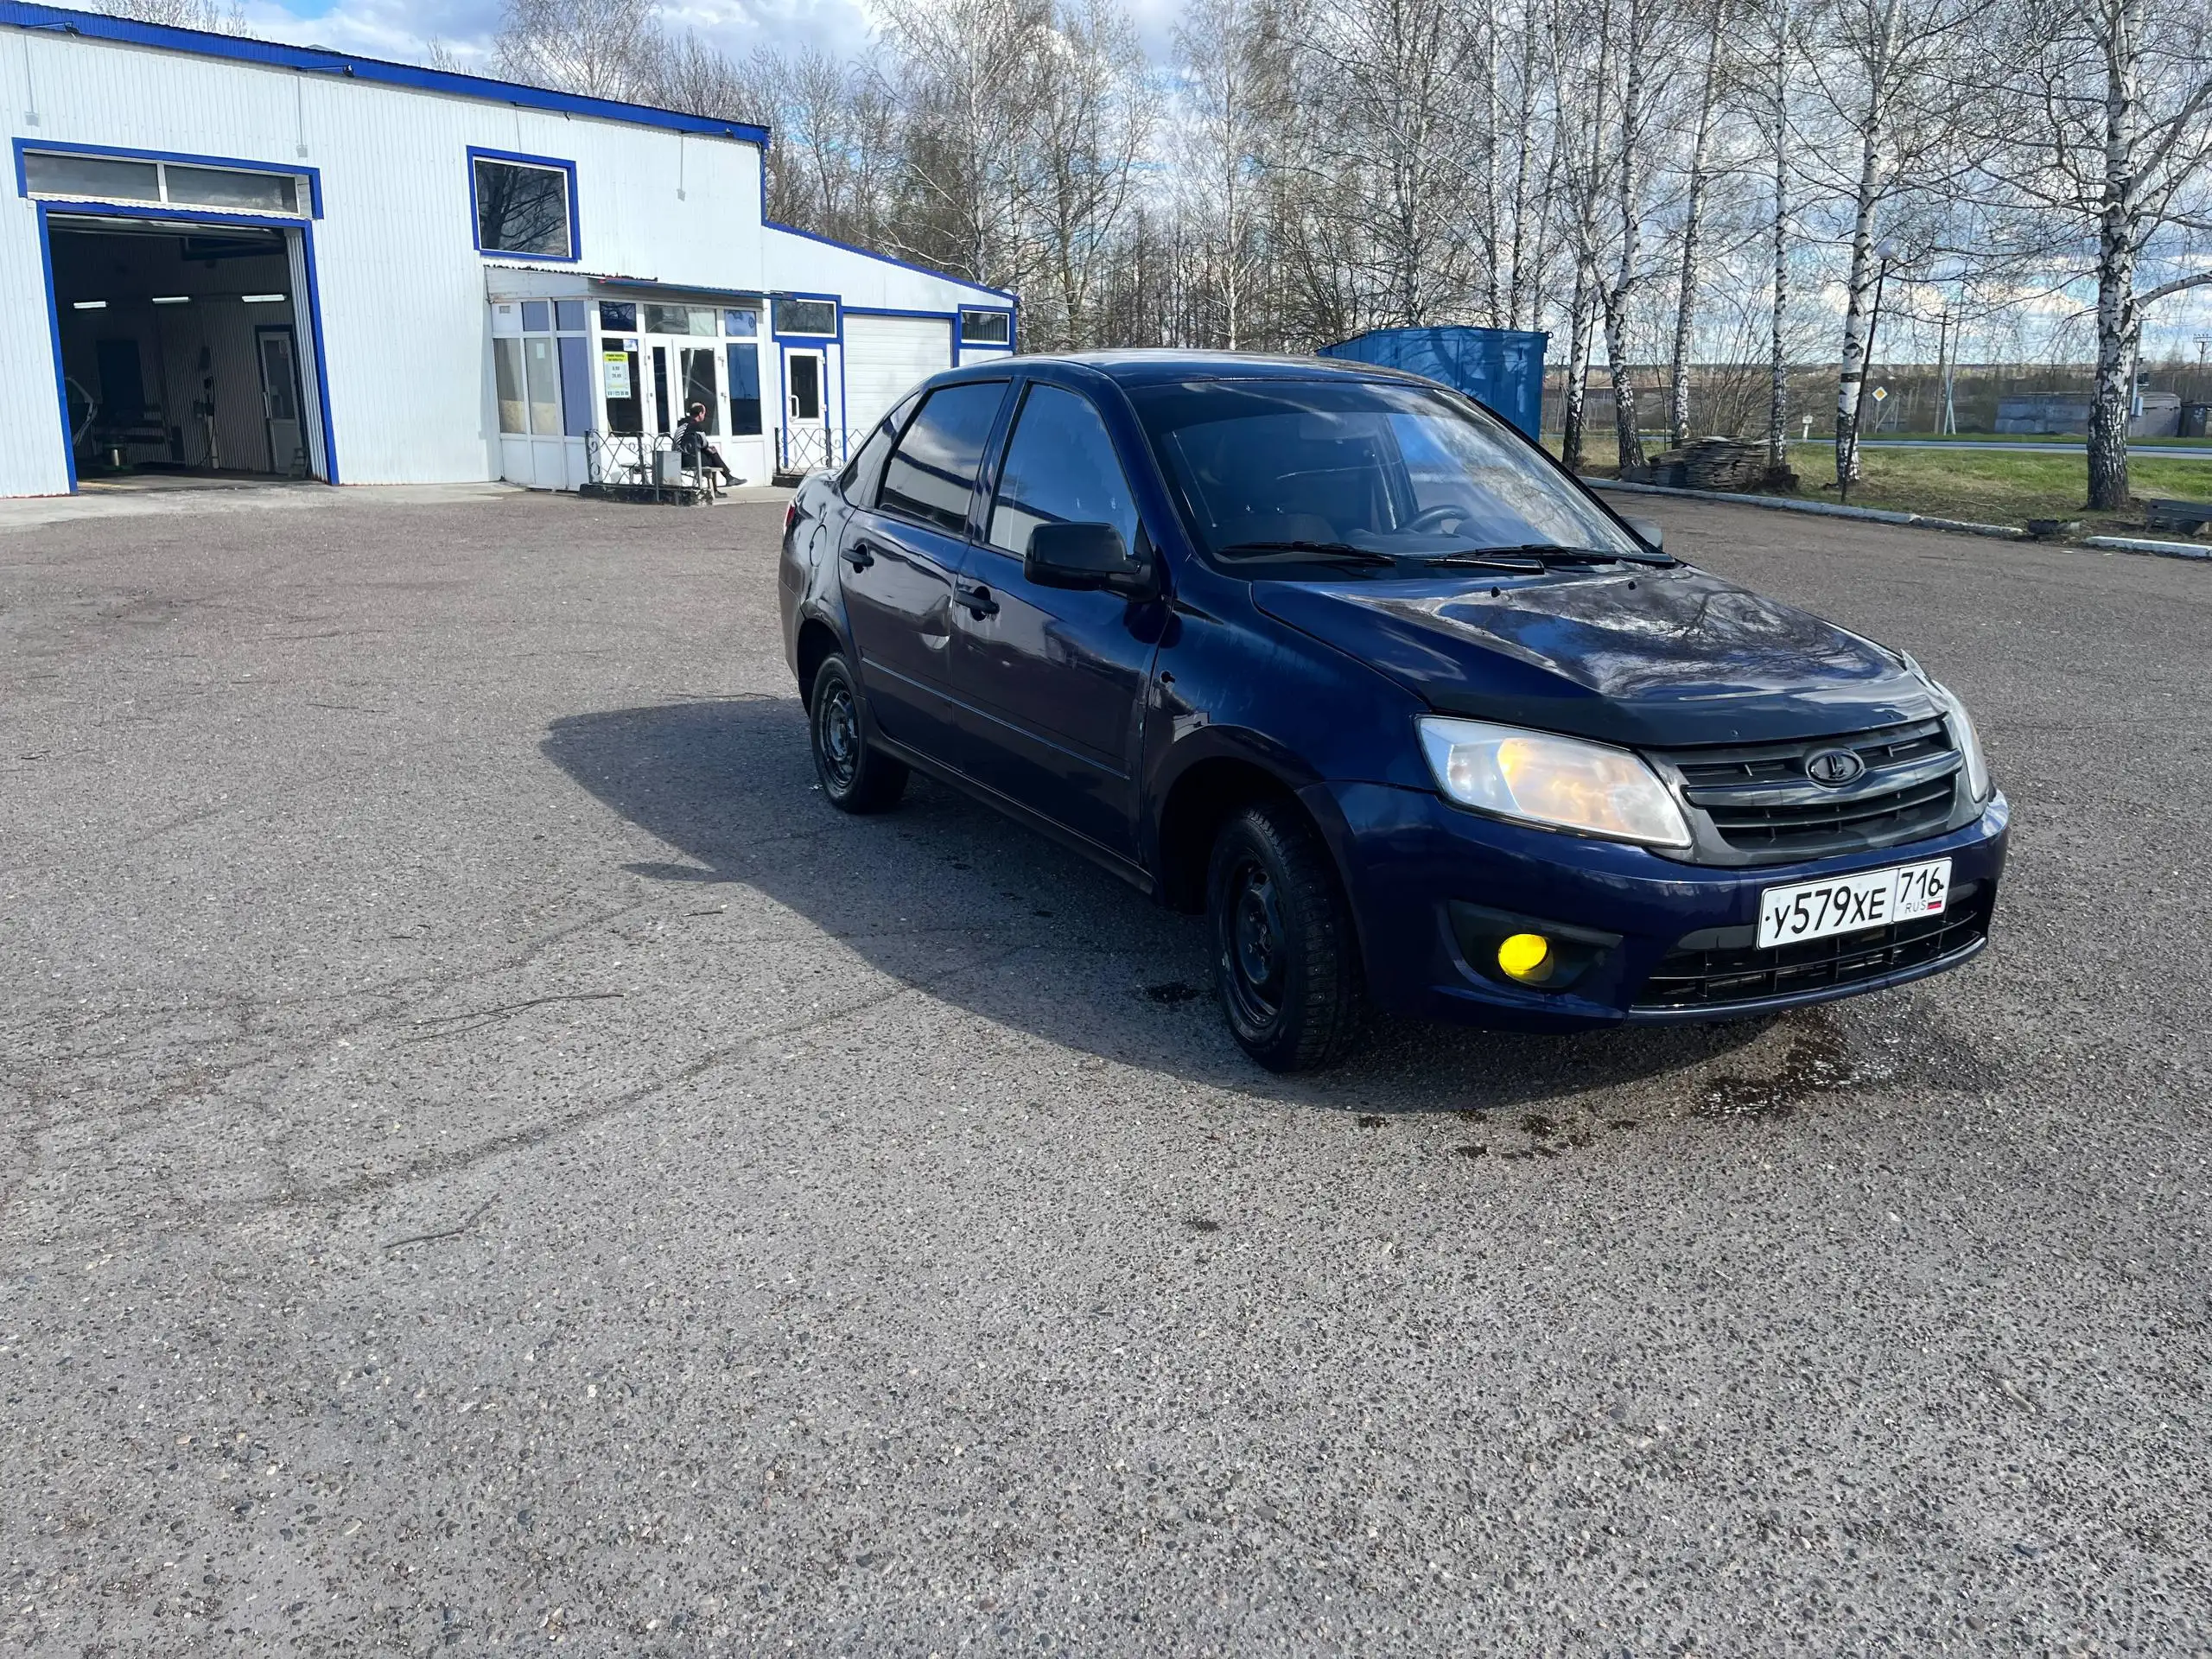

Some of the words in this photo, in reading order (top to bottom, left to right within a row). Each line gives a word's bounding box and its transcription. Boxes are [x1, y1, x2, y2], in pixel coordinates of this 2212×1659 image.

[1774, 886, 1886, 938] У579ХЕ
[1901, 867, 1942, 904] 716
[1904, 899, 1927, 914] RUS
